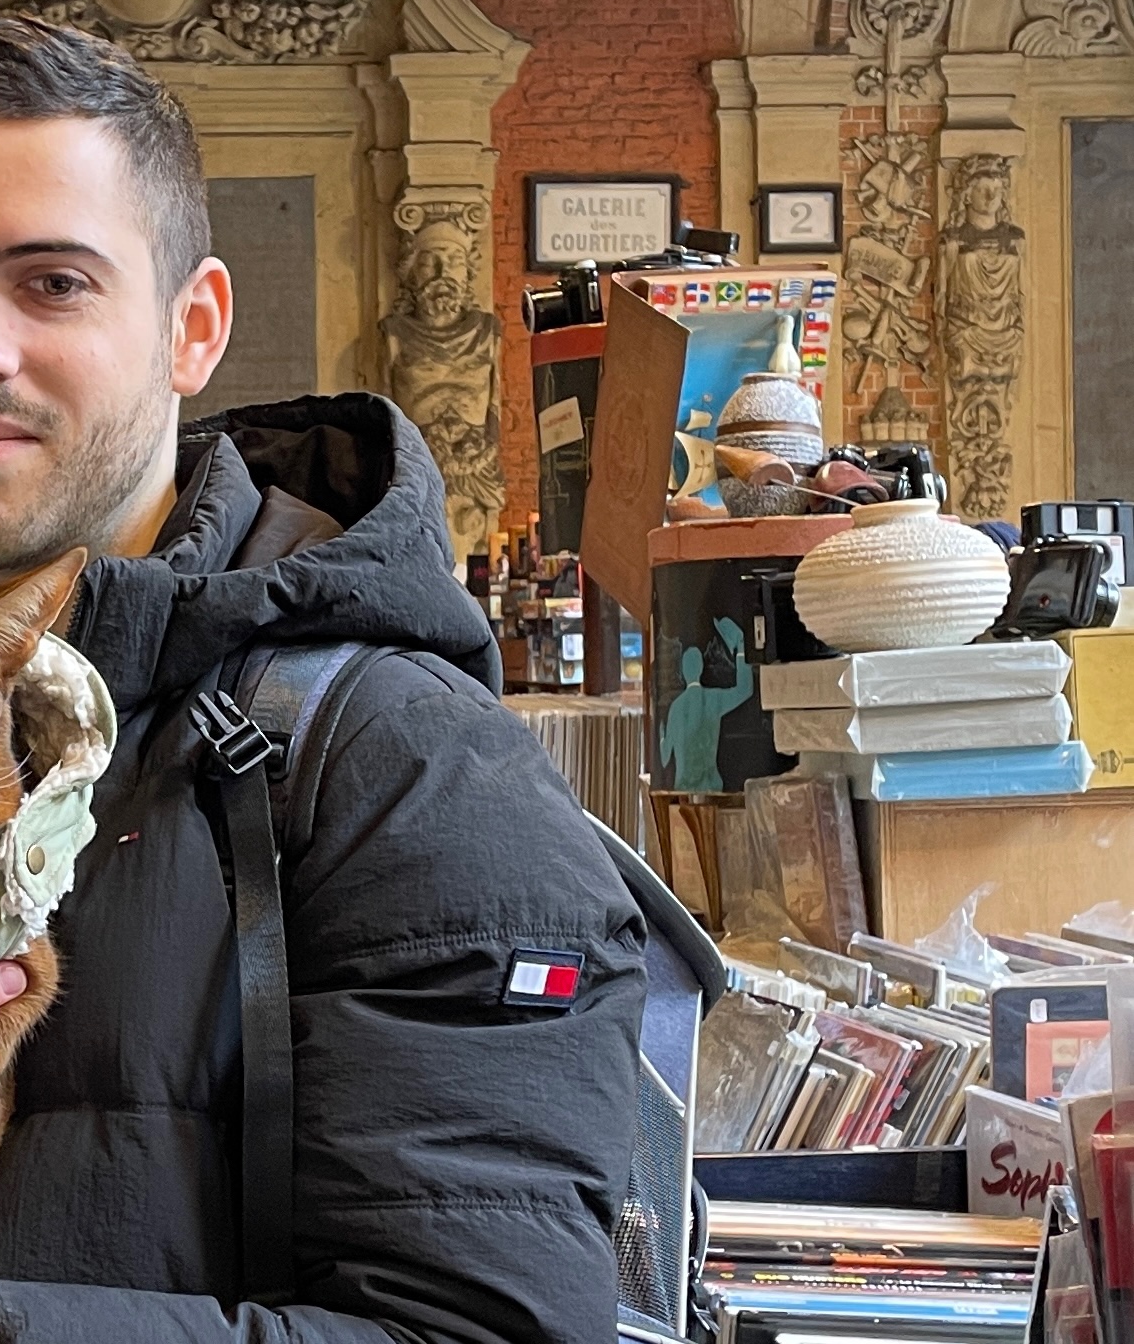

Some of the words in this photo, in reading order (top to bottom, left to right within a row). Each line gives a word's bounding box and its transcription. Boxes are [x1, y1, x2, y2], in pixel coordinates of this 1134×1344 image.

[562, 197, 646, 217] GALERIE
[591, 218, 617, 231] des
[789, 202, 813, 233] 2
[551, 233, 657, 253] COURTIERS
